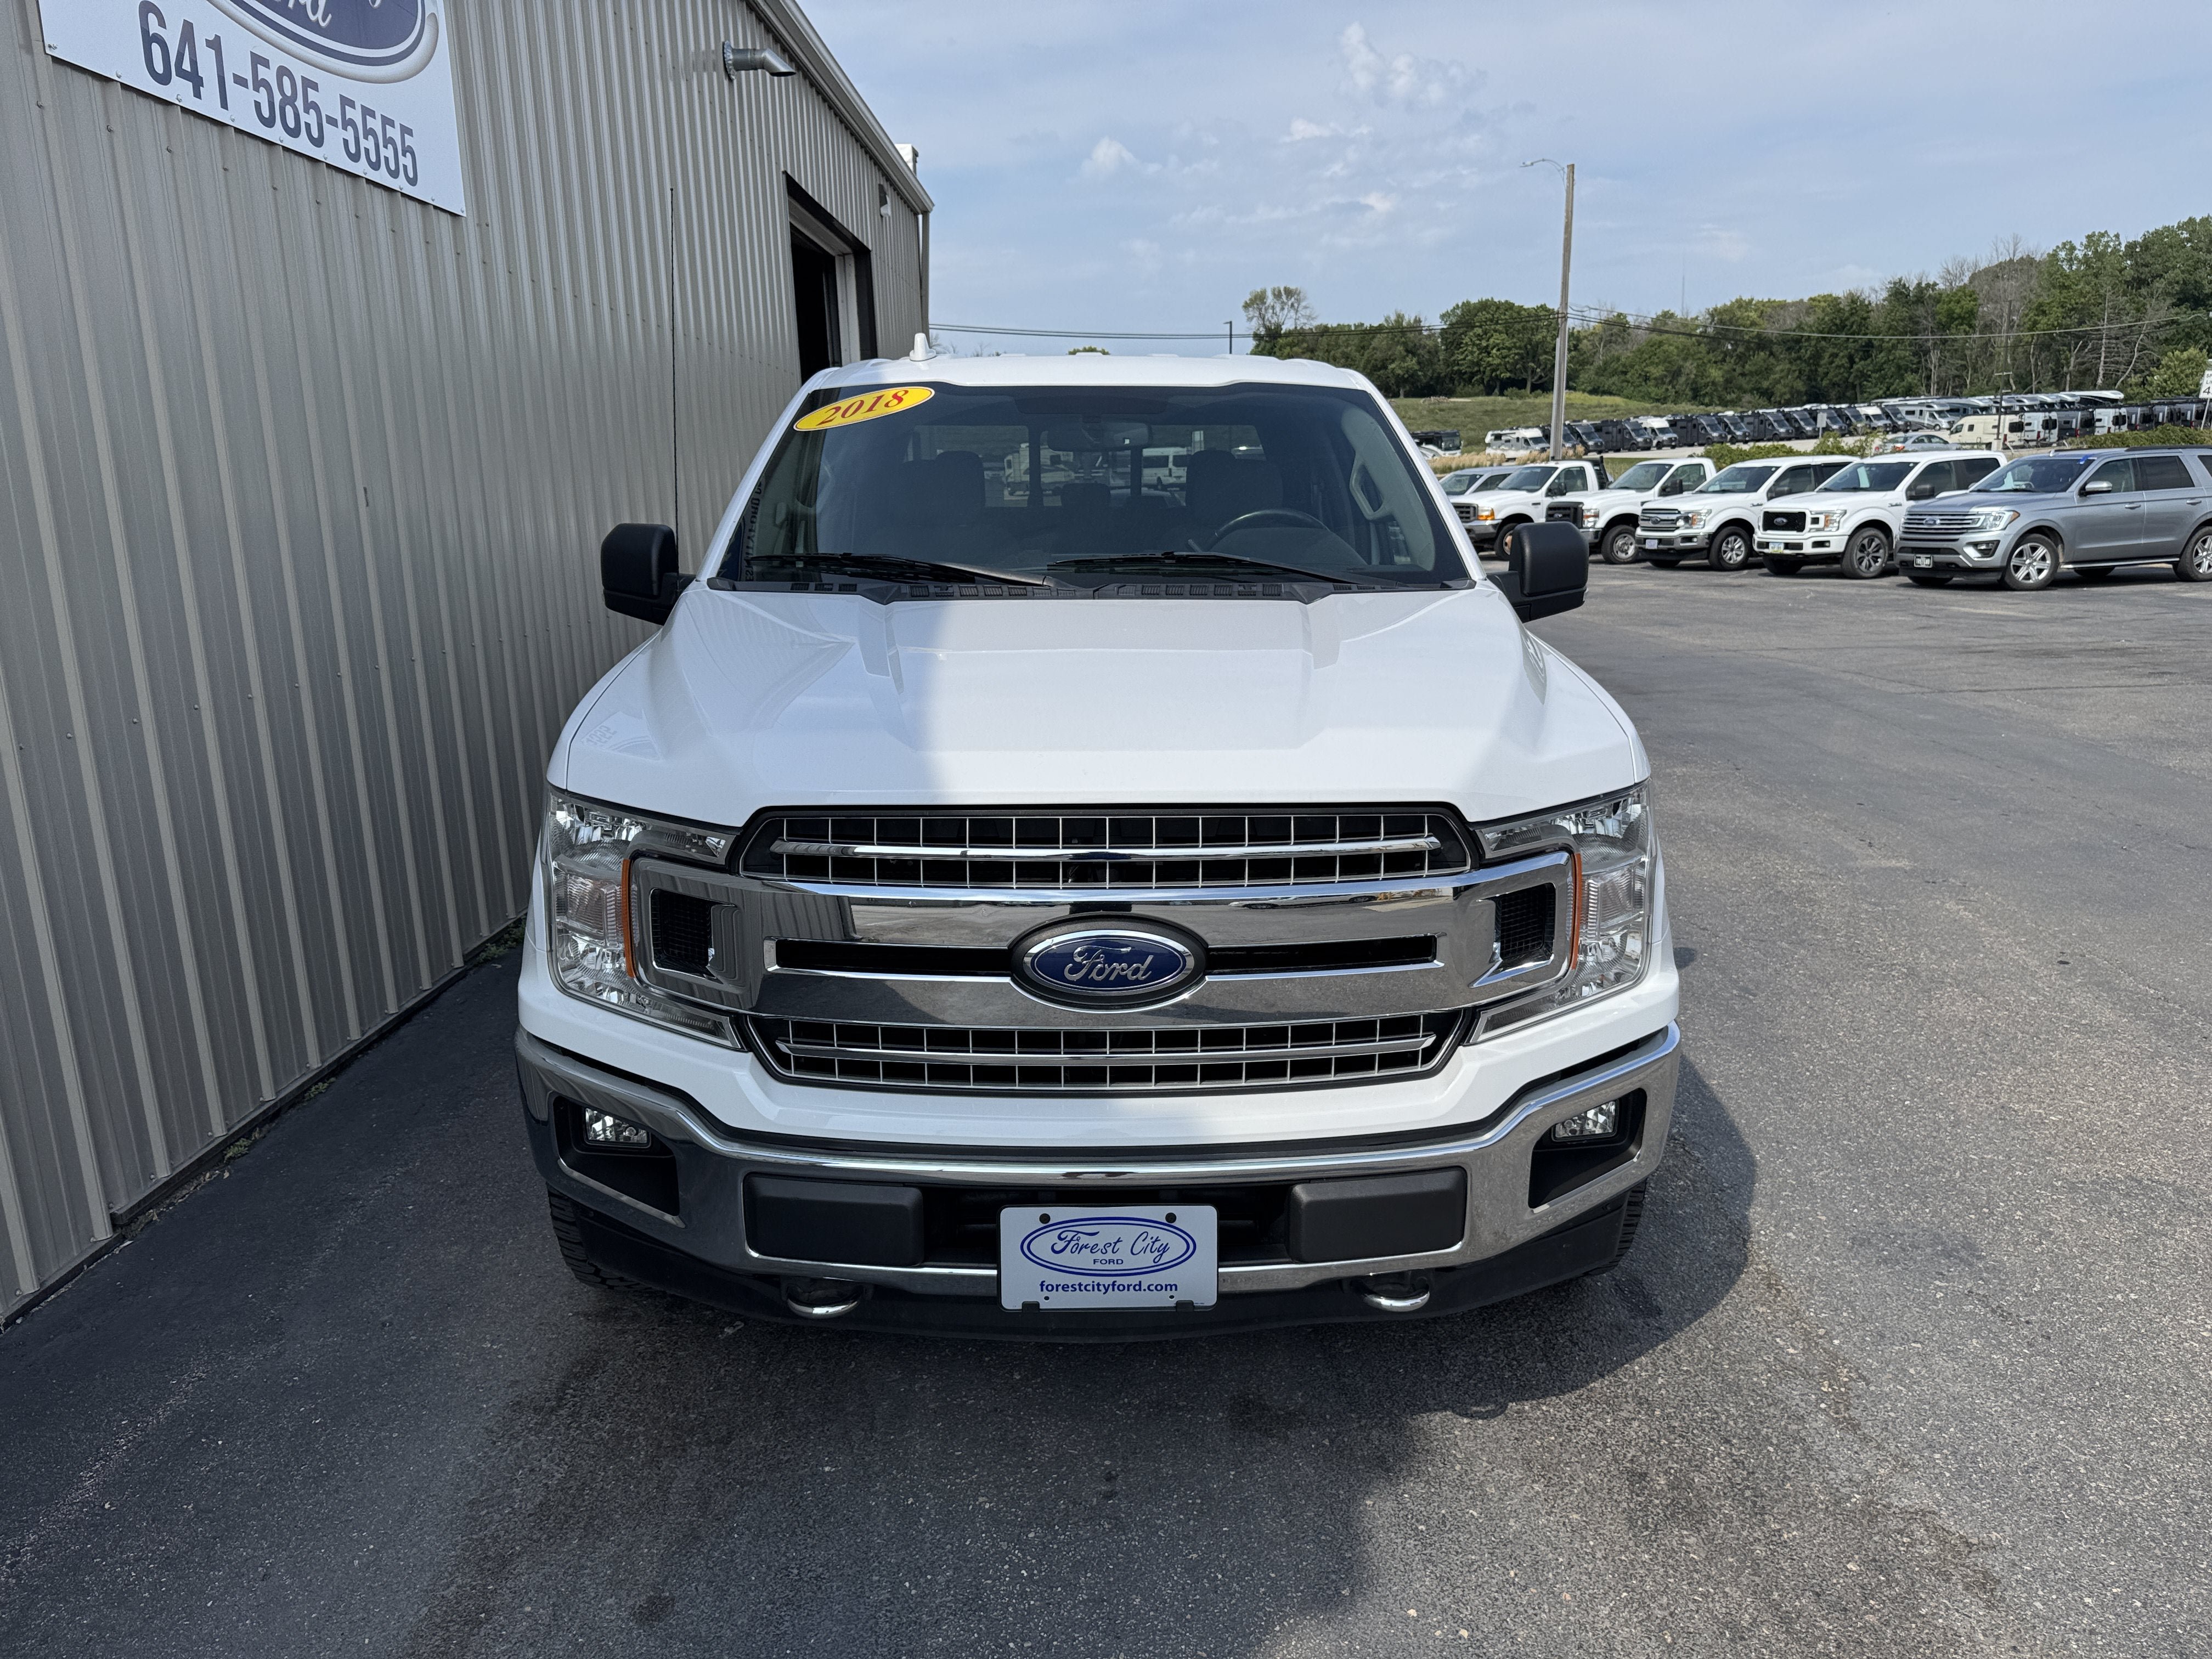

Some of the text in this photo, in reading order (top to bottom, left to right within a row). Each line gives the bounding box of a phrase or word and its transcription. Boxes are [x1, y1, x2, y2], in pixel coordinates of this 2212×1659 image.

[138, 0, 419, 187] 641-585-5555
[816, 390, 909, 426] 2018
[1064, 945, 1154, 981] Ford
[1051, 1229, 1170, 1263] Forest City
[1039, 1280, 1178, 1295] forestcityford.com
